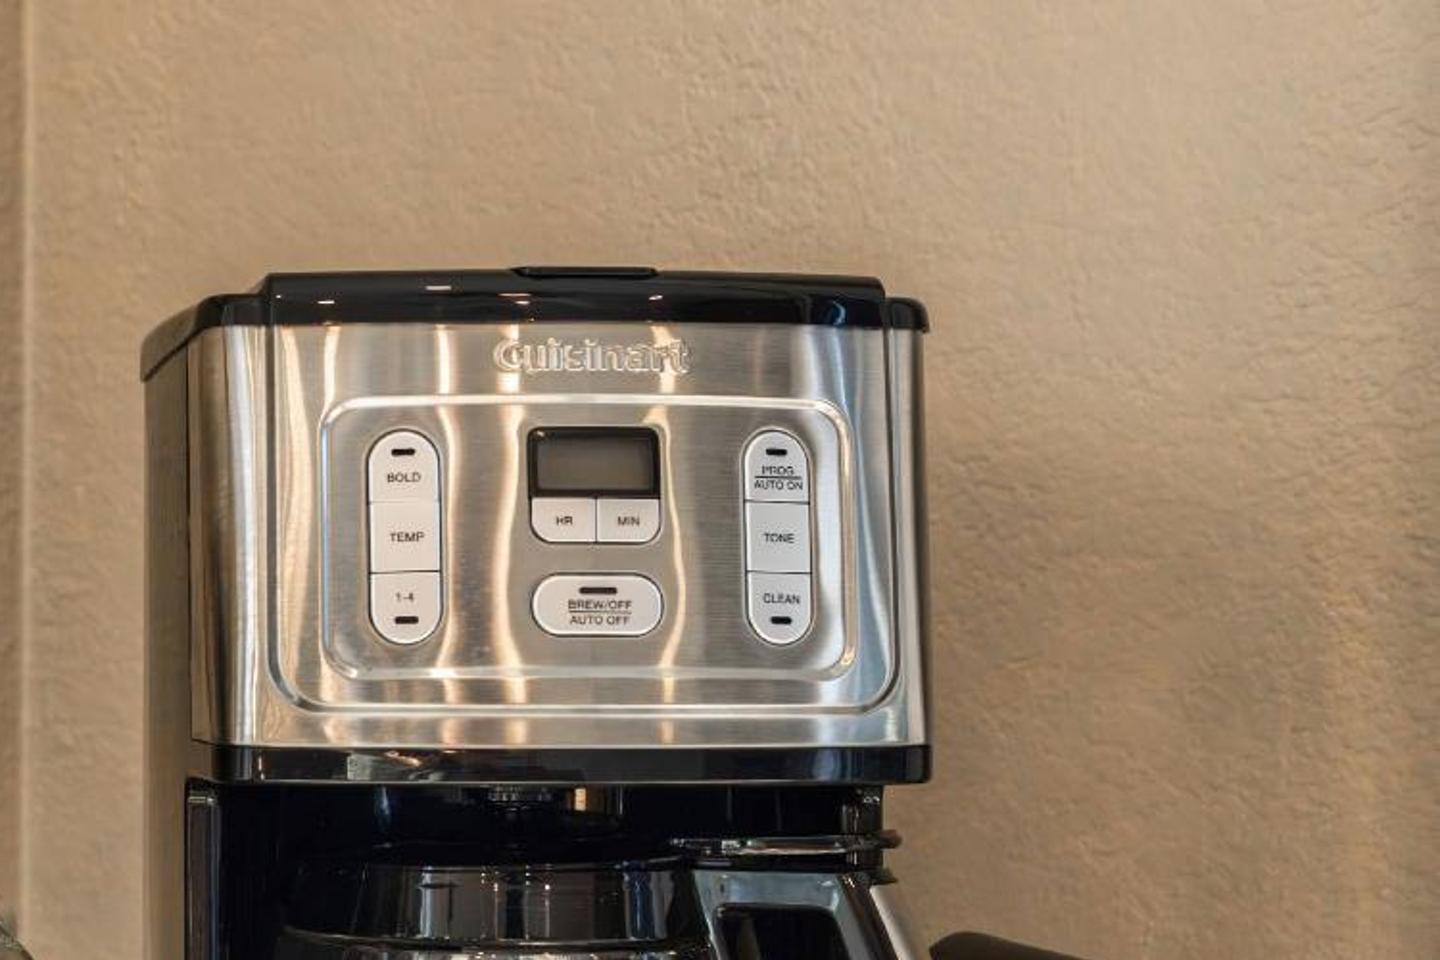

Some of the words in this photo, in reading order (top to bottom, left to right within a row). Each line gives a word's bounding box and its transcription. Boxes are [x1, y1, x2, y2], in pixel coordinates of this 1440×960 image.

[493, 337, 689, 374] Cuisinart
[387, 472, 421, 483] BOLD
[754, 479, 783, 490] AUTO
[786, 480, 803, 490] ON
[556, 515, 573, 525] HR
[617, 515, 641, 527] MIN
[390, 531, 424, 543] TEMP
[764, 532, 795, 544] TONE
[395, 591, 414, 603] 1-4
[763, 593, 800, 605] CLEAN
[568, 600, 632, 610] BREW/OFF
[569, 614, 603, 626] AUTO
[607, 613, 630, 626] OFF
